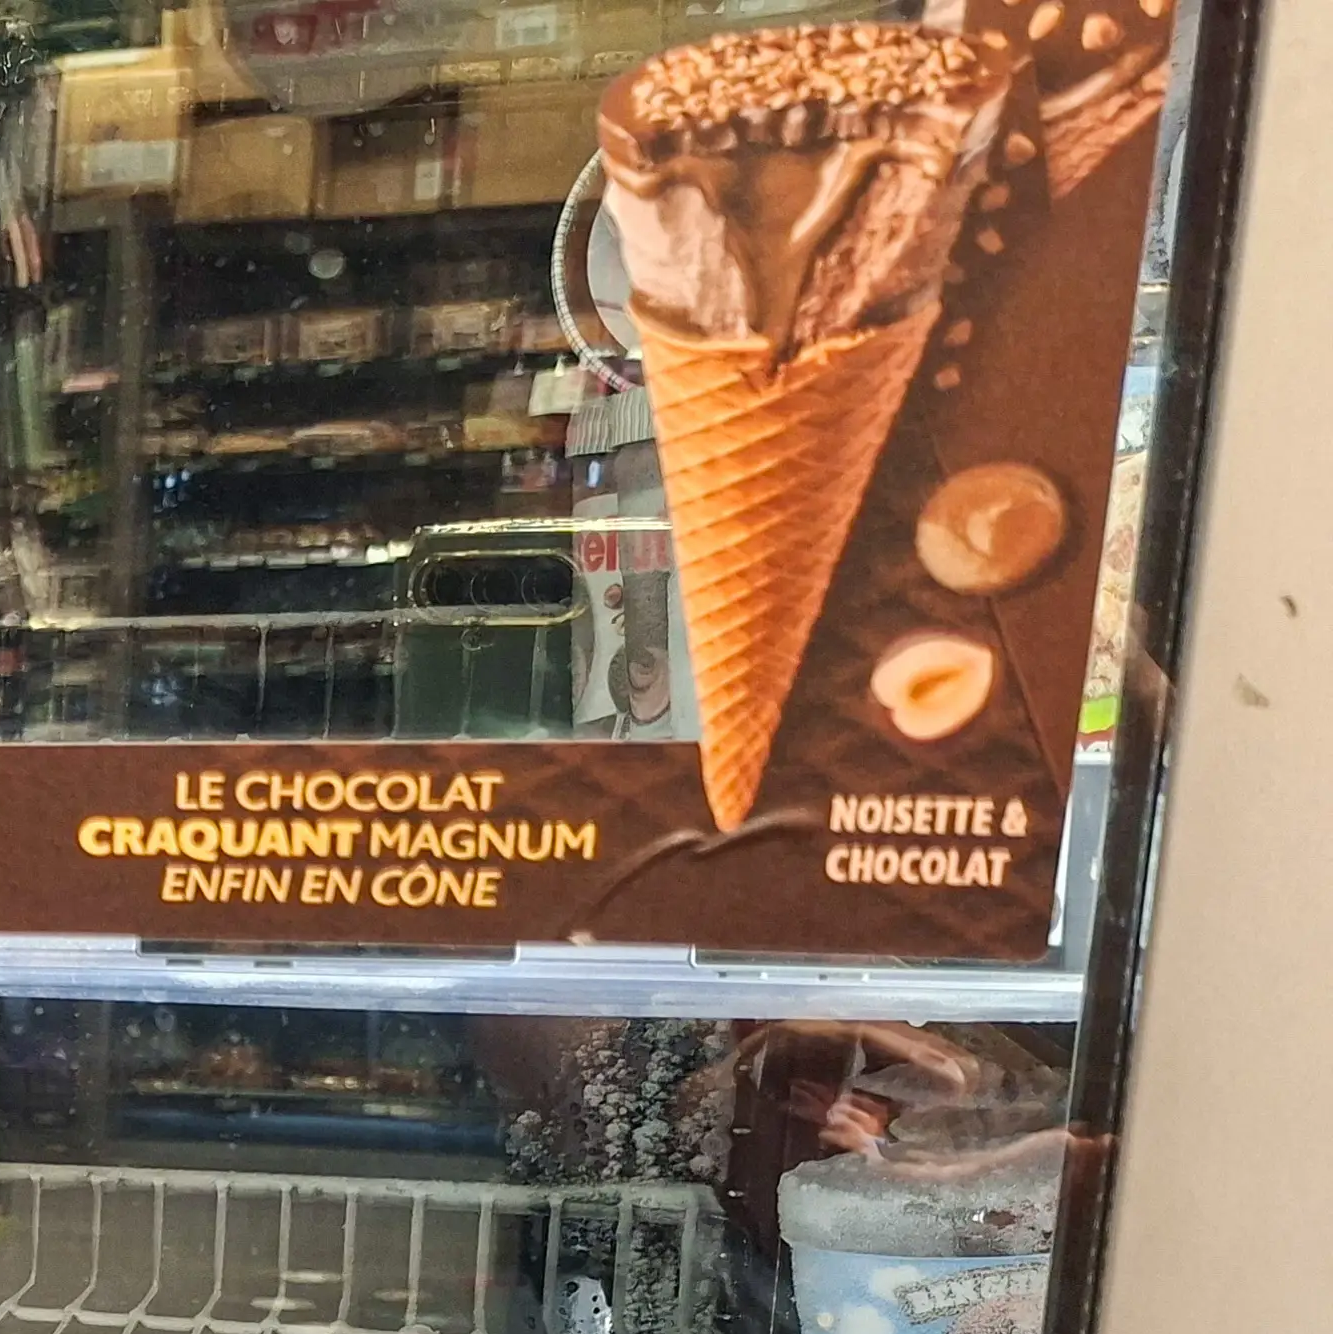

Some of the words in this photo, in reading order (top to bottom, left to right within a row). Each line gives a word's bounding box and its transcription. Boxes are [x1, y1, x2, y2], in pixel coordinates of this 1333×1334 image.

[175, 771, 225, 810] LE
[235, 770, 504, 813] CHOCOLAT
[829, 793, 995, 836] NOISETTE
[1001, 795, 1028, 837] &
[78, 816, 362, 861] CRAQUANT
[370, 819, 597, 861] MAGNUM
[161, 865, 291, 904] ENFIN
[300, 867, 363, 905] EN
[371, 861, 503, 908] CÔNE
[825, 842, 1012, 888] CHOCOLAT
